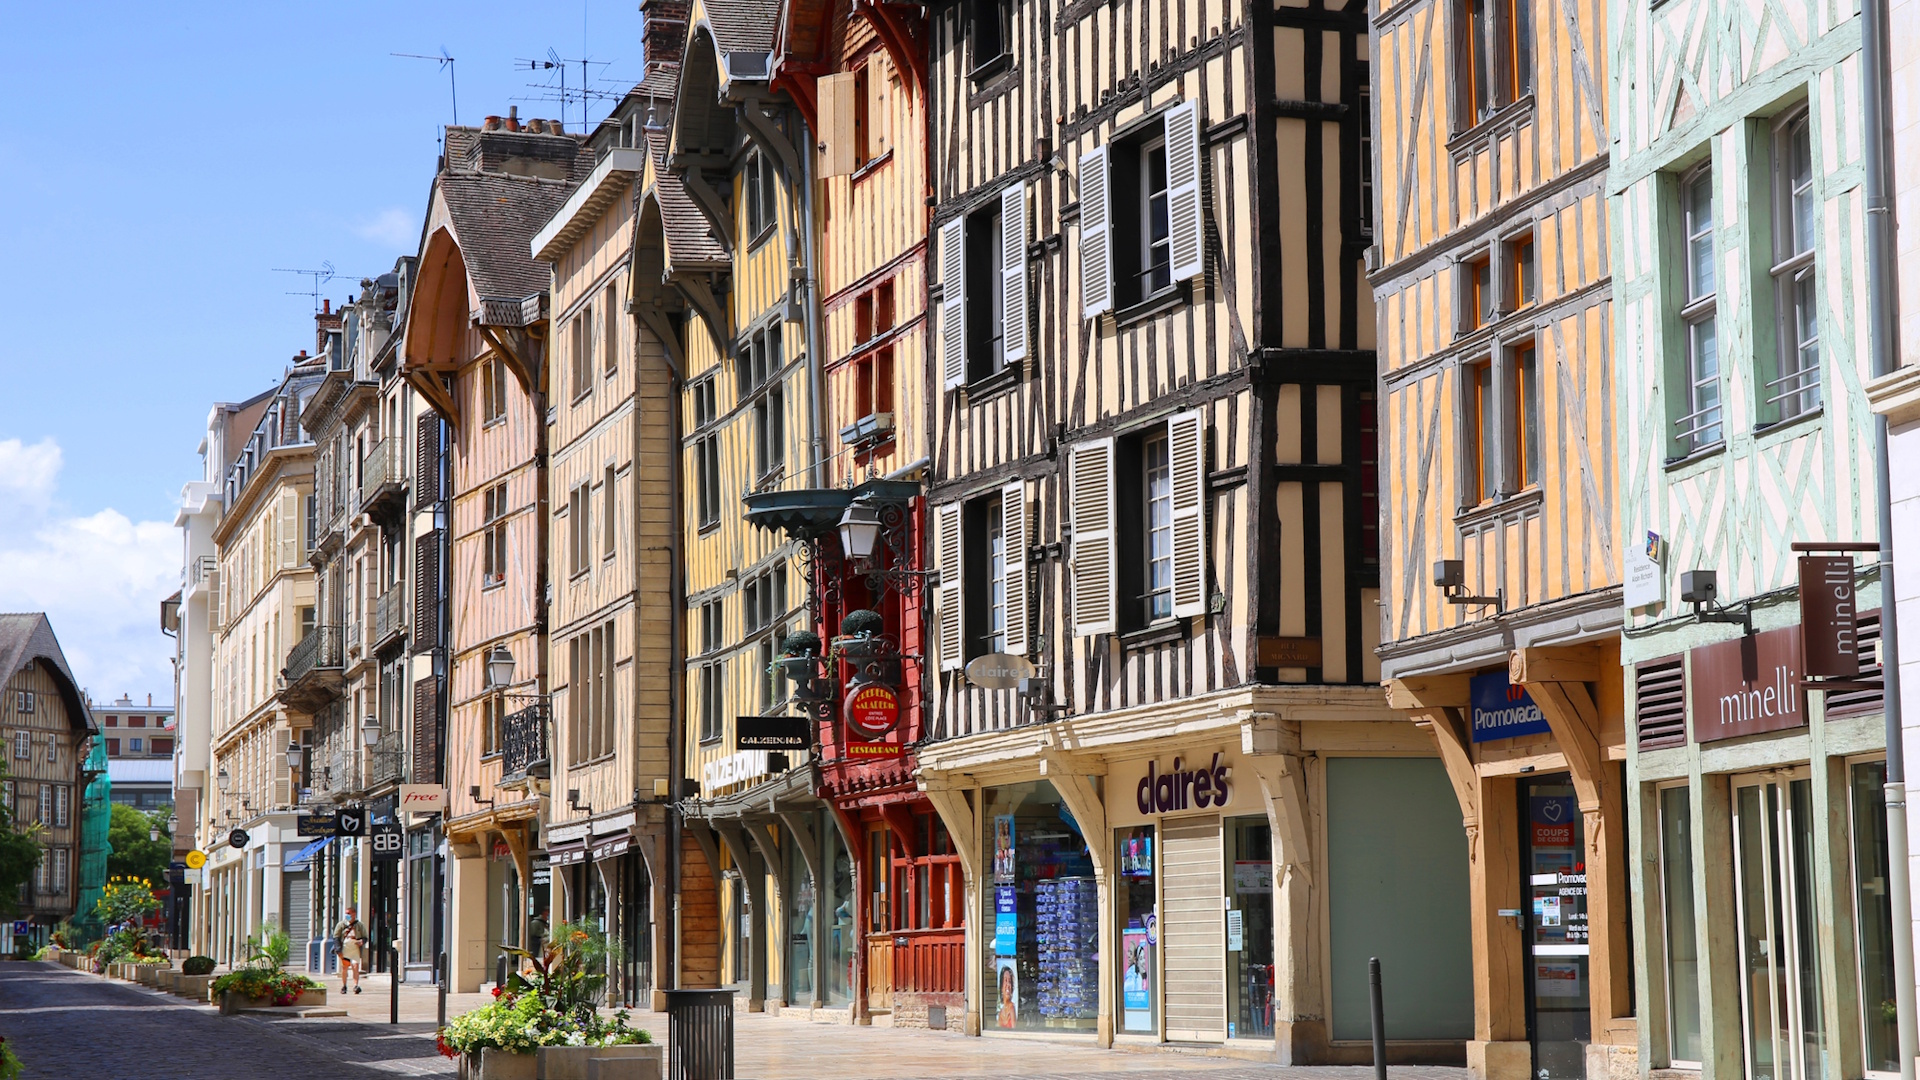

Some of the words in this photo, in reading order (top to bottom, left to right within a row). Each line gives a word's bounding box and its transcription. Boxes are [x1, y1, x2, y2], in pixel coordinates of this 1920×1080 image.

[1824, 561, 1853, 655] minelli
[1280, 642, 1297, 650] RUE
[1271, 653, 1309, 661] MIGNARD
[974, 665, 1031, 678] claire's
[1720, 665, 1796, 725] minelli
[740, 736, 803, 744] CALZEDONIA
[850, 746, 899, 754] RESTAURANT
[704, 748, 766, 792] CALZEDONIA
[1137, 752, 1230, 815] claire's
[404, 791, 438, 804] free
[1536, 828, 1570, 837] COUPS
[1121, 854, 1151, 872] PIERCING
